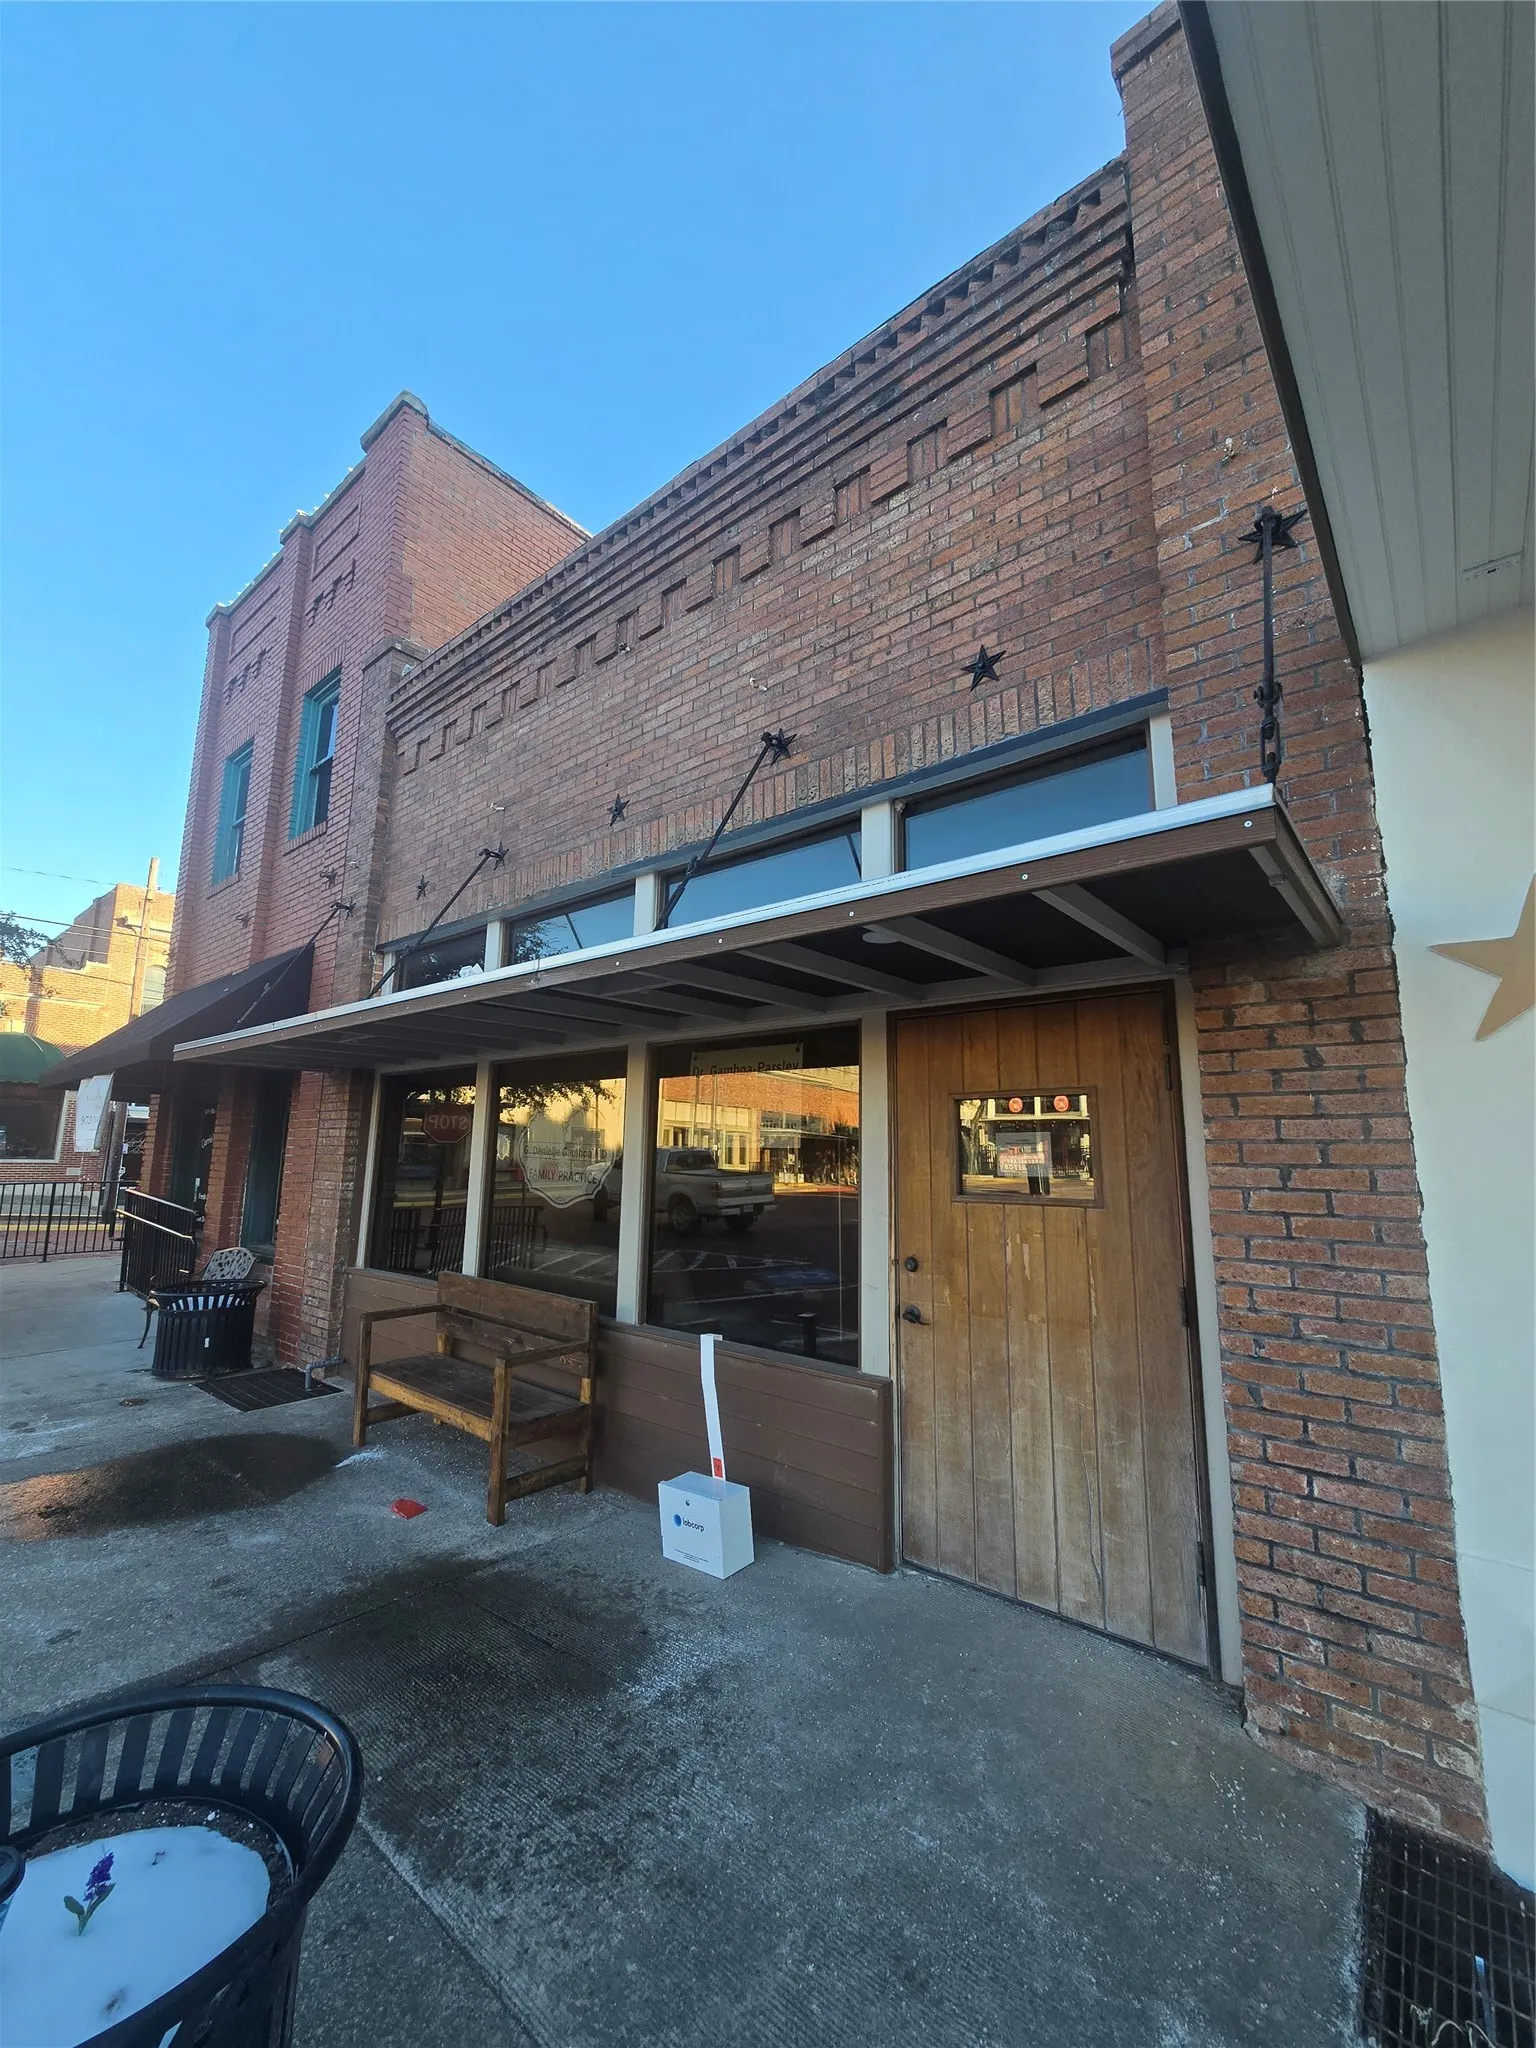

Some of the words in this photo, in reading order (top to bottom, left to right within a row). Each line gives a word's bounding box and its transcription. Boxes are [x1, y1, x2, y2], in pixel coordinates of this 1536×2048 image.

[532, 1145, 560, 1157] Danielle
[529, 1167, 556, 1181] FAMILY
[558, 1170, 598, 1184] PRACTICE
[682, 1517, 705, 1533] labcorp
